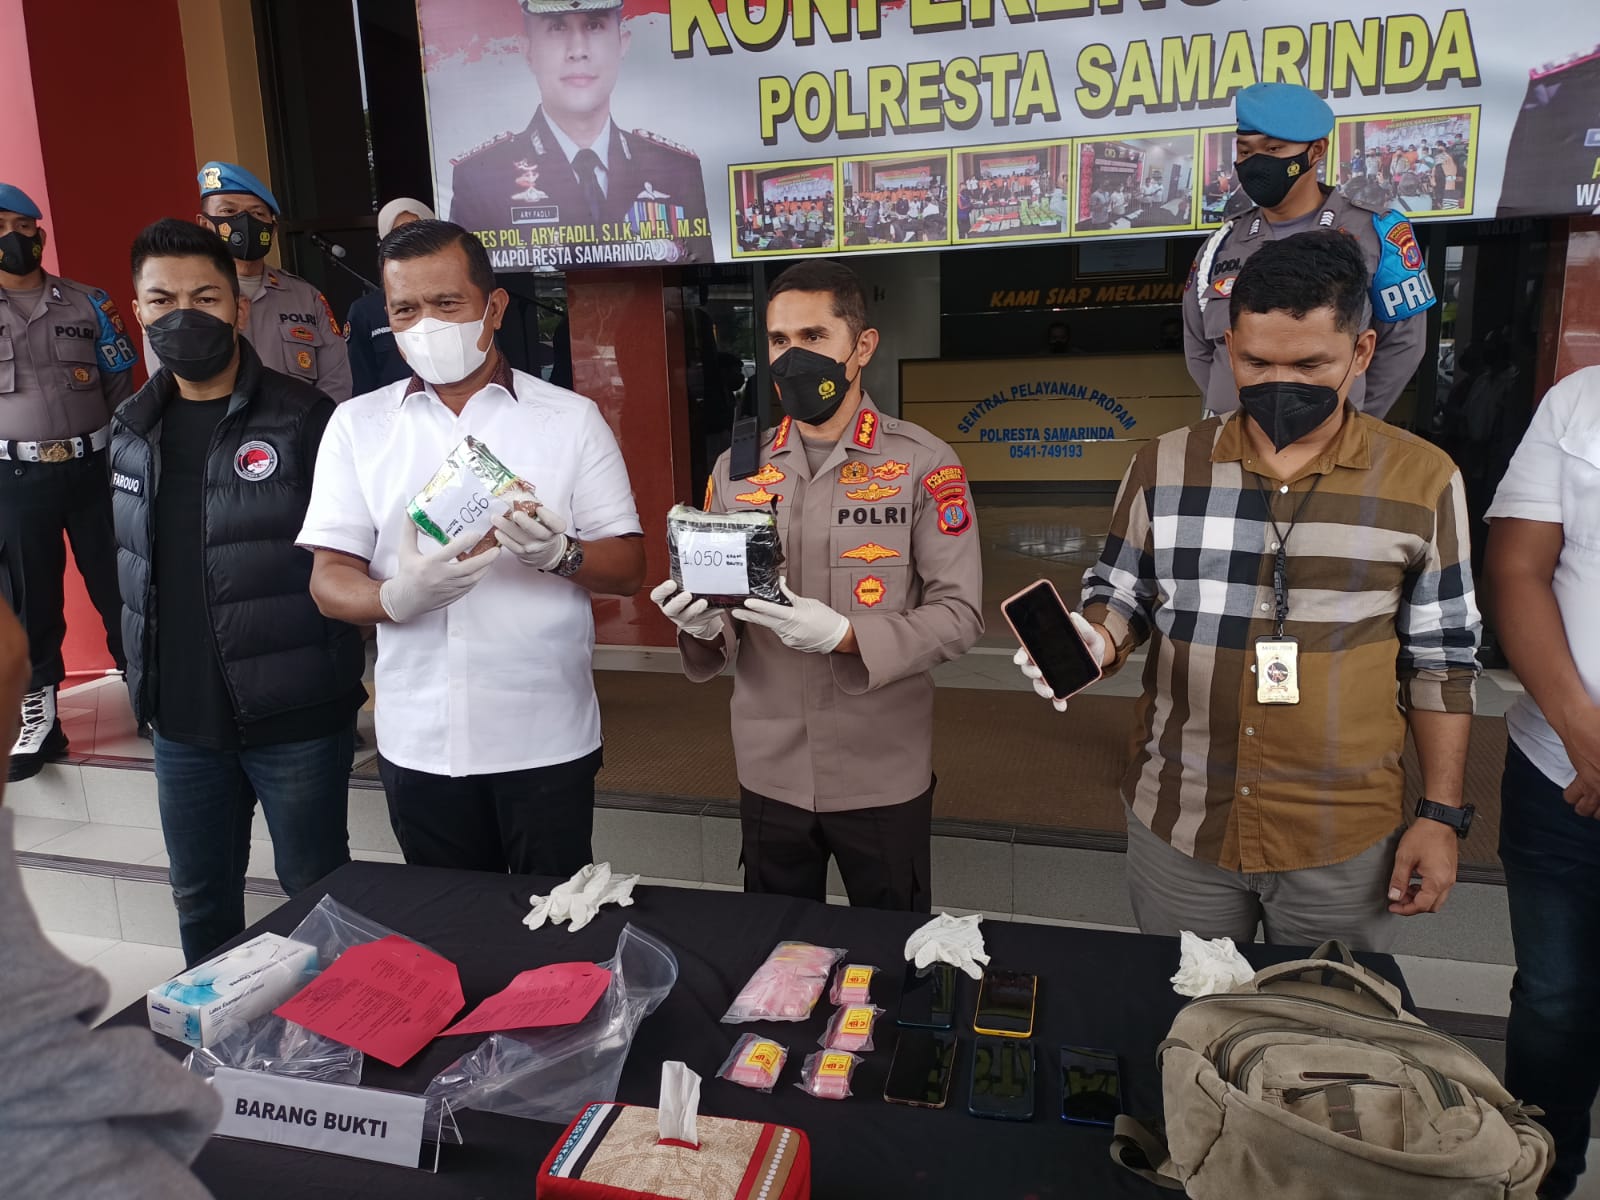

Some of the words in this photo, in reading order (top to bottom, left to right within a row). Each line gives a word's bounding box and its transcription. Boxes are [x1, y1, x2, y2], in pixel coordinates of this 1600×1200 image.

[758, 49, 1060, 144] POLRESTA
[1074, 8, 1481, 118] SAMARINDA
[500, 229, 528, 247] POL.
[531, 227, 555, 245] ARY
[559, 224, 599, 244] FADLI,
[492, 246, 572, 268] KAPOLRESTA
[575, 242, 654, 264] SAMARINDA
[990, 289, 1040, 307] KAMI
[1046, 286, 1091, 304] SIAP
[280, 313, 316, 325] POLRI
[55, 326, 94, 339] POLRI
[957, 391, 1009, 434] SENTRAL
[1011, 381, 1087, 400] PELAYANAN
[1088, 389, 1137, 431] PROPAM
[980, 428, 1040, 442] POLRESTA
[1044, 426, 1115, 441] SAMARINDA
[1009, 444, 1083, 458] 0541-749193
[113, 472, 139, 493] FAROUQ
[459, 492, 489, 524] 950
[838, 507, 906, 525] POLRI
[682, 550, 723, 567] 1.050
[235, 1098, 318, 1127] BARANG
[322, 1111, 388, 1139] BUKTI
